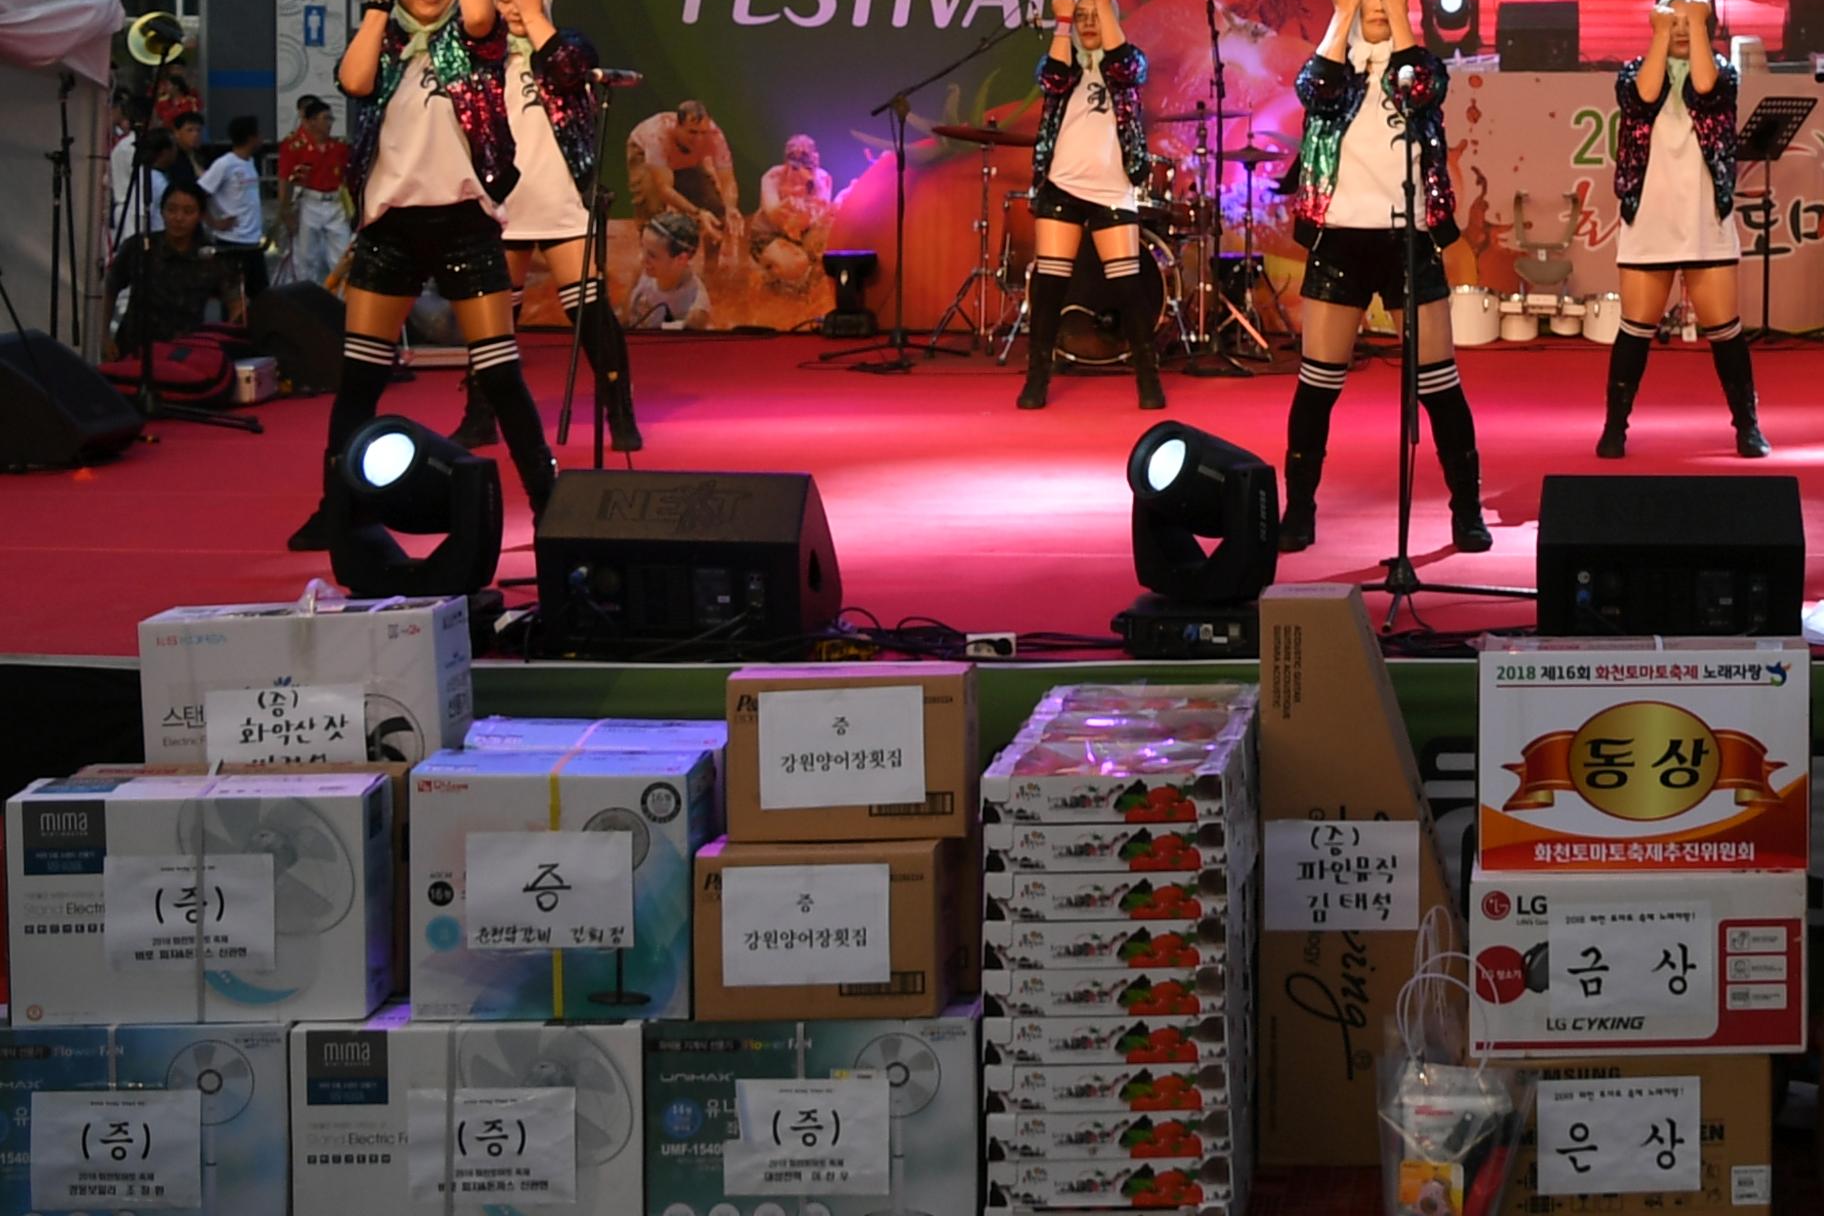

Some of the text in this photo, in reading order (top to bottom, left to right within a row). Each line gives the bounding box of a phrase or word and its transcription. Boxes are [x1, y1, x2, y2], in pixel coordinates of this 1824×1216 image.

[1497, 663, 1762, 680] 2018 제16회 화천토마토축제 노래자랑
[257, 689, 299, 718] (증)
[239, 717, 315, 746] 화악산
[831, 716, 850, 736] 증
[781, 748, 902, 774] 강원양어장횟집
[1311, 825, 1360, 857] (증)
[1534, 843, 1755, 864] 화천토마토축제추진위원회
[1296, 856, 1397, 884] 파인뮤직
[522, 863, 572, 912] 증
[155, 886, 225, 924] (증)
[796, 894, 815, 913] 증
[1517, 895, 1547, 915] LG
[744, 927, 867, 951] 강원양어장횟집
[1546, 1016, 1646, 1031] LG CYKING
[82, 1121, 150, 1160] (증)
[458, 1119, 526, 1157] (증)
[772, 1109, 840, 1147] (증)
